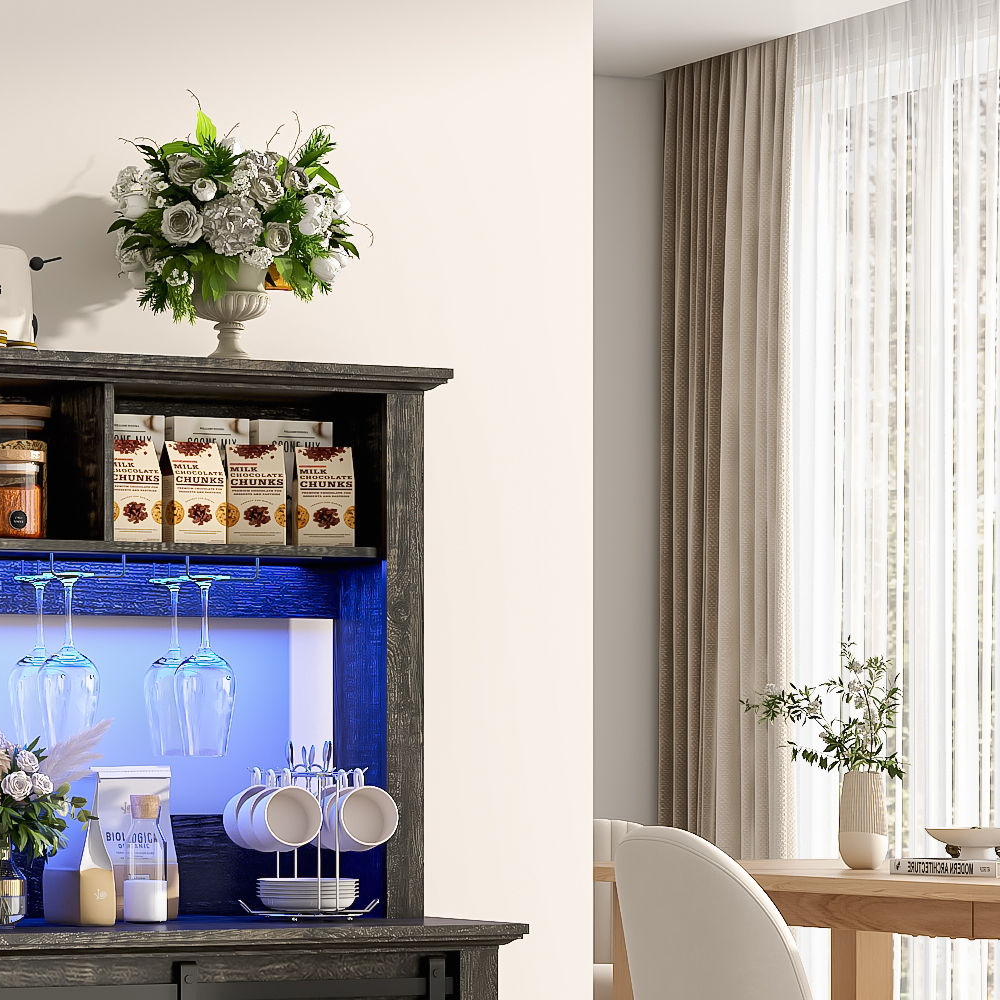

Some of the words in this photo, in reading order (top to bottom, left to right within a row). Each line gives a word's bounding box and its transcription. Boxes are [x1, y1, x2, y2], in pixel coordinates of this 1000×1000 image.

[114, 474, 159, 482] CHUNKS
[175, 475, 224, 484] CHUNKS
[230, 478, 284, 486] CHUNKS
[300, 480, 353, 488] CHUNKS
